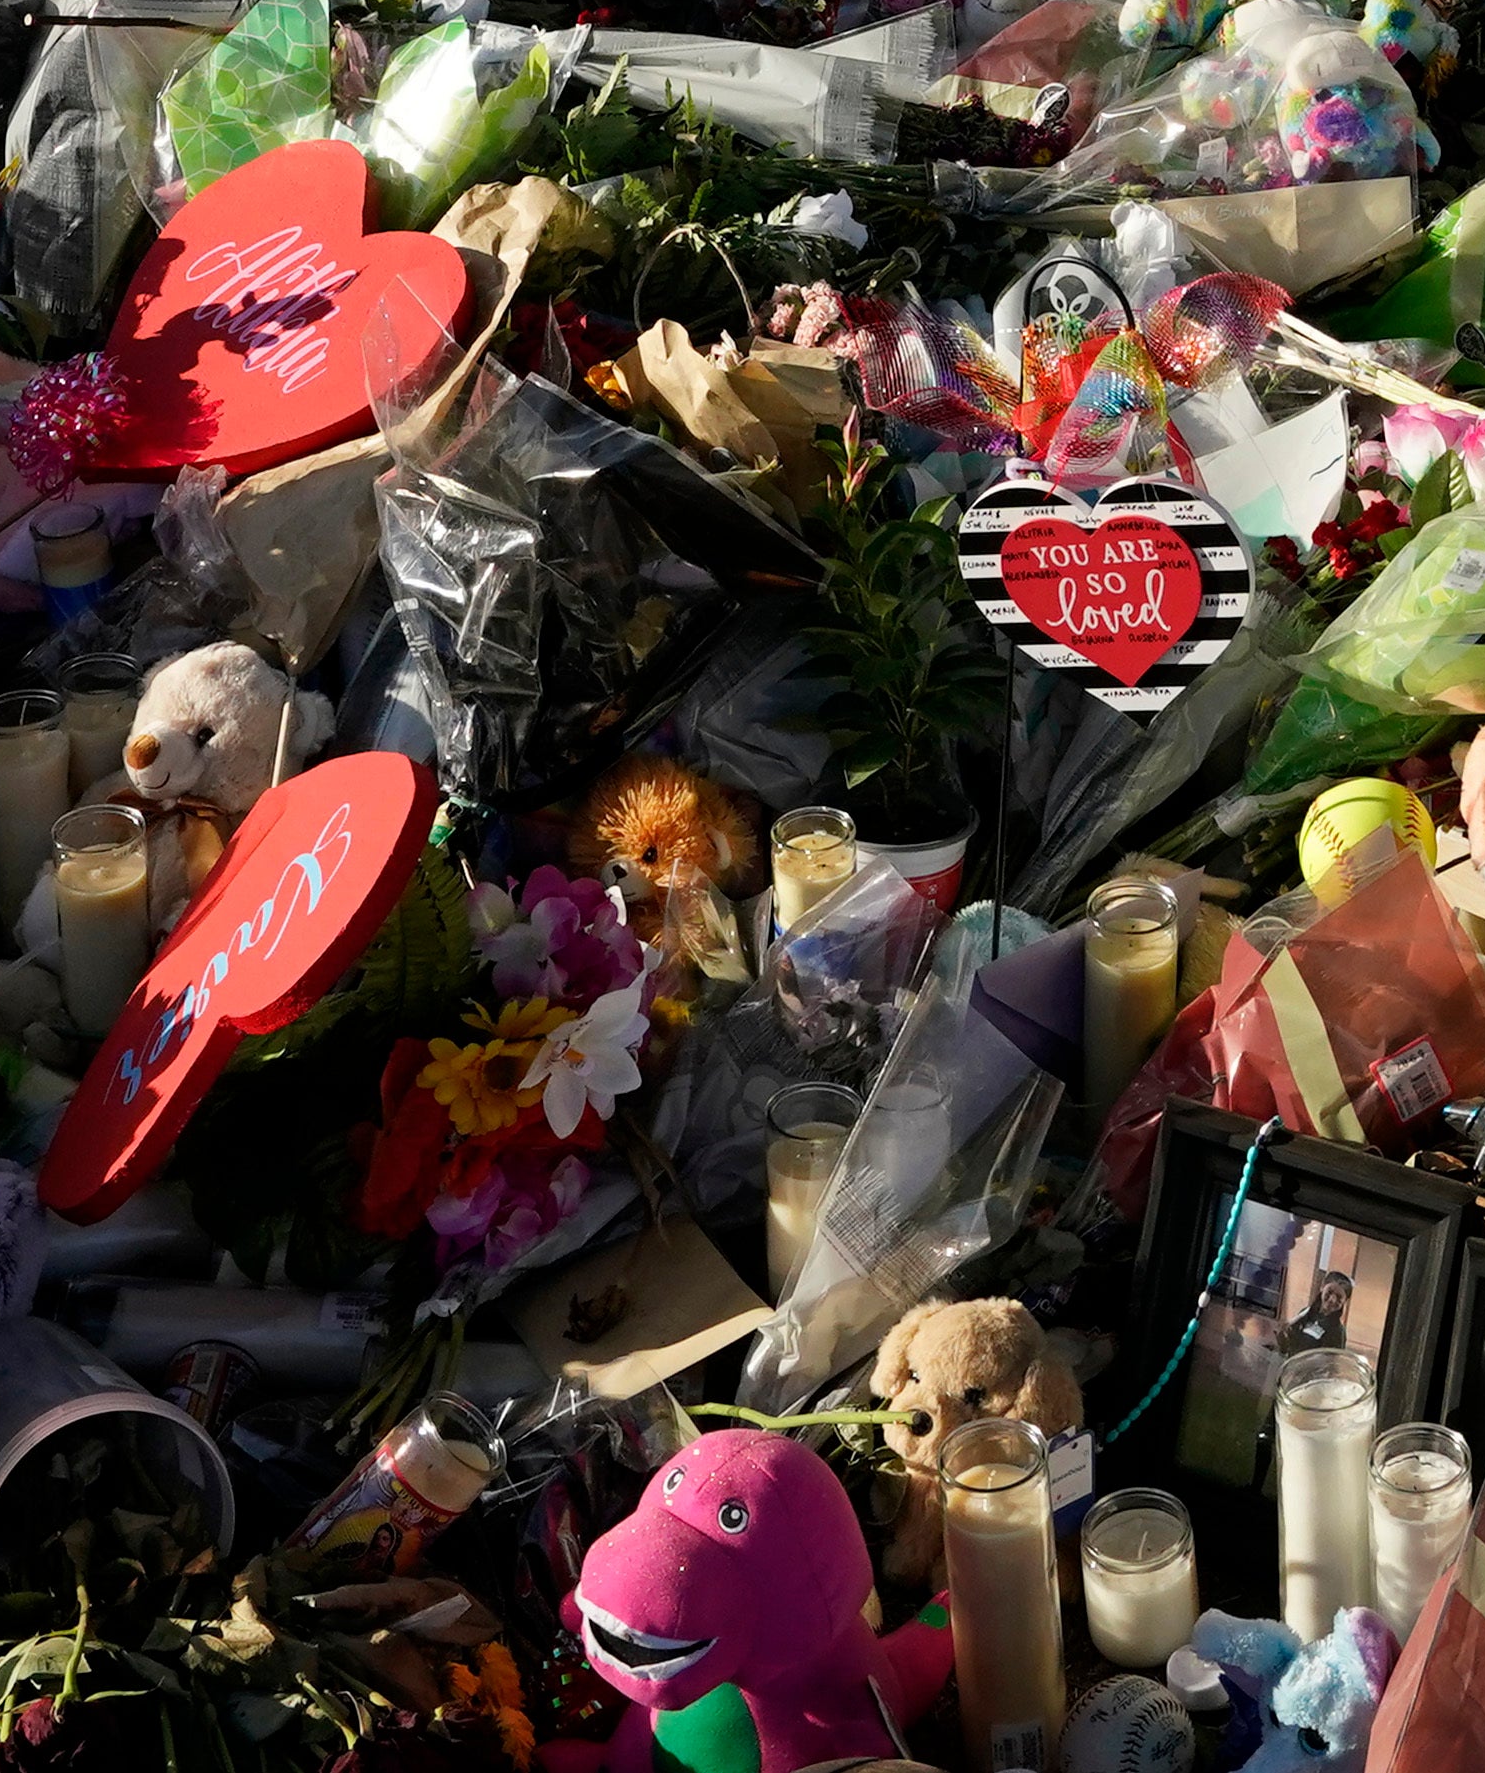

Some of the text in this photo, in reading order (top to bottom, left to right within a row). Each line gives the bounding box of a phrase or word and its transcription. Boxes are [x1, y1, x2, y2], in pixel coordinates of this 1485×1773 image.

[1029, 538, 1159, 569] YOU ARE
[1045, 569, 1172, 636] loved
[1086, 572, 1127, 595] SO
[105, 802, 353, 1113] Xavier
